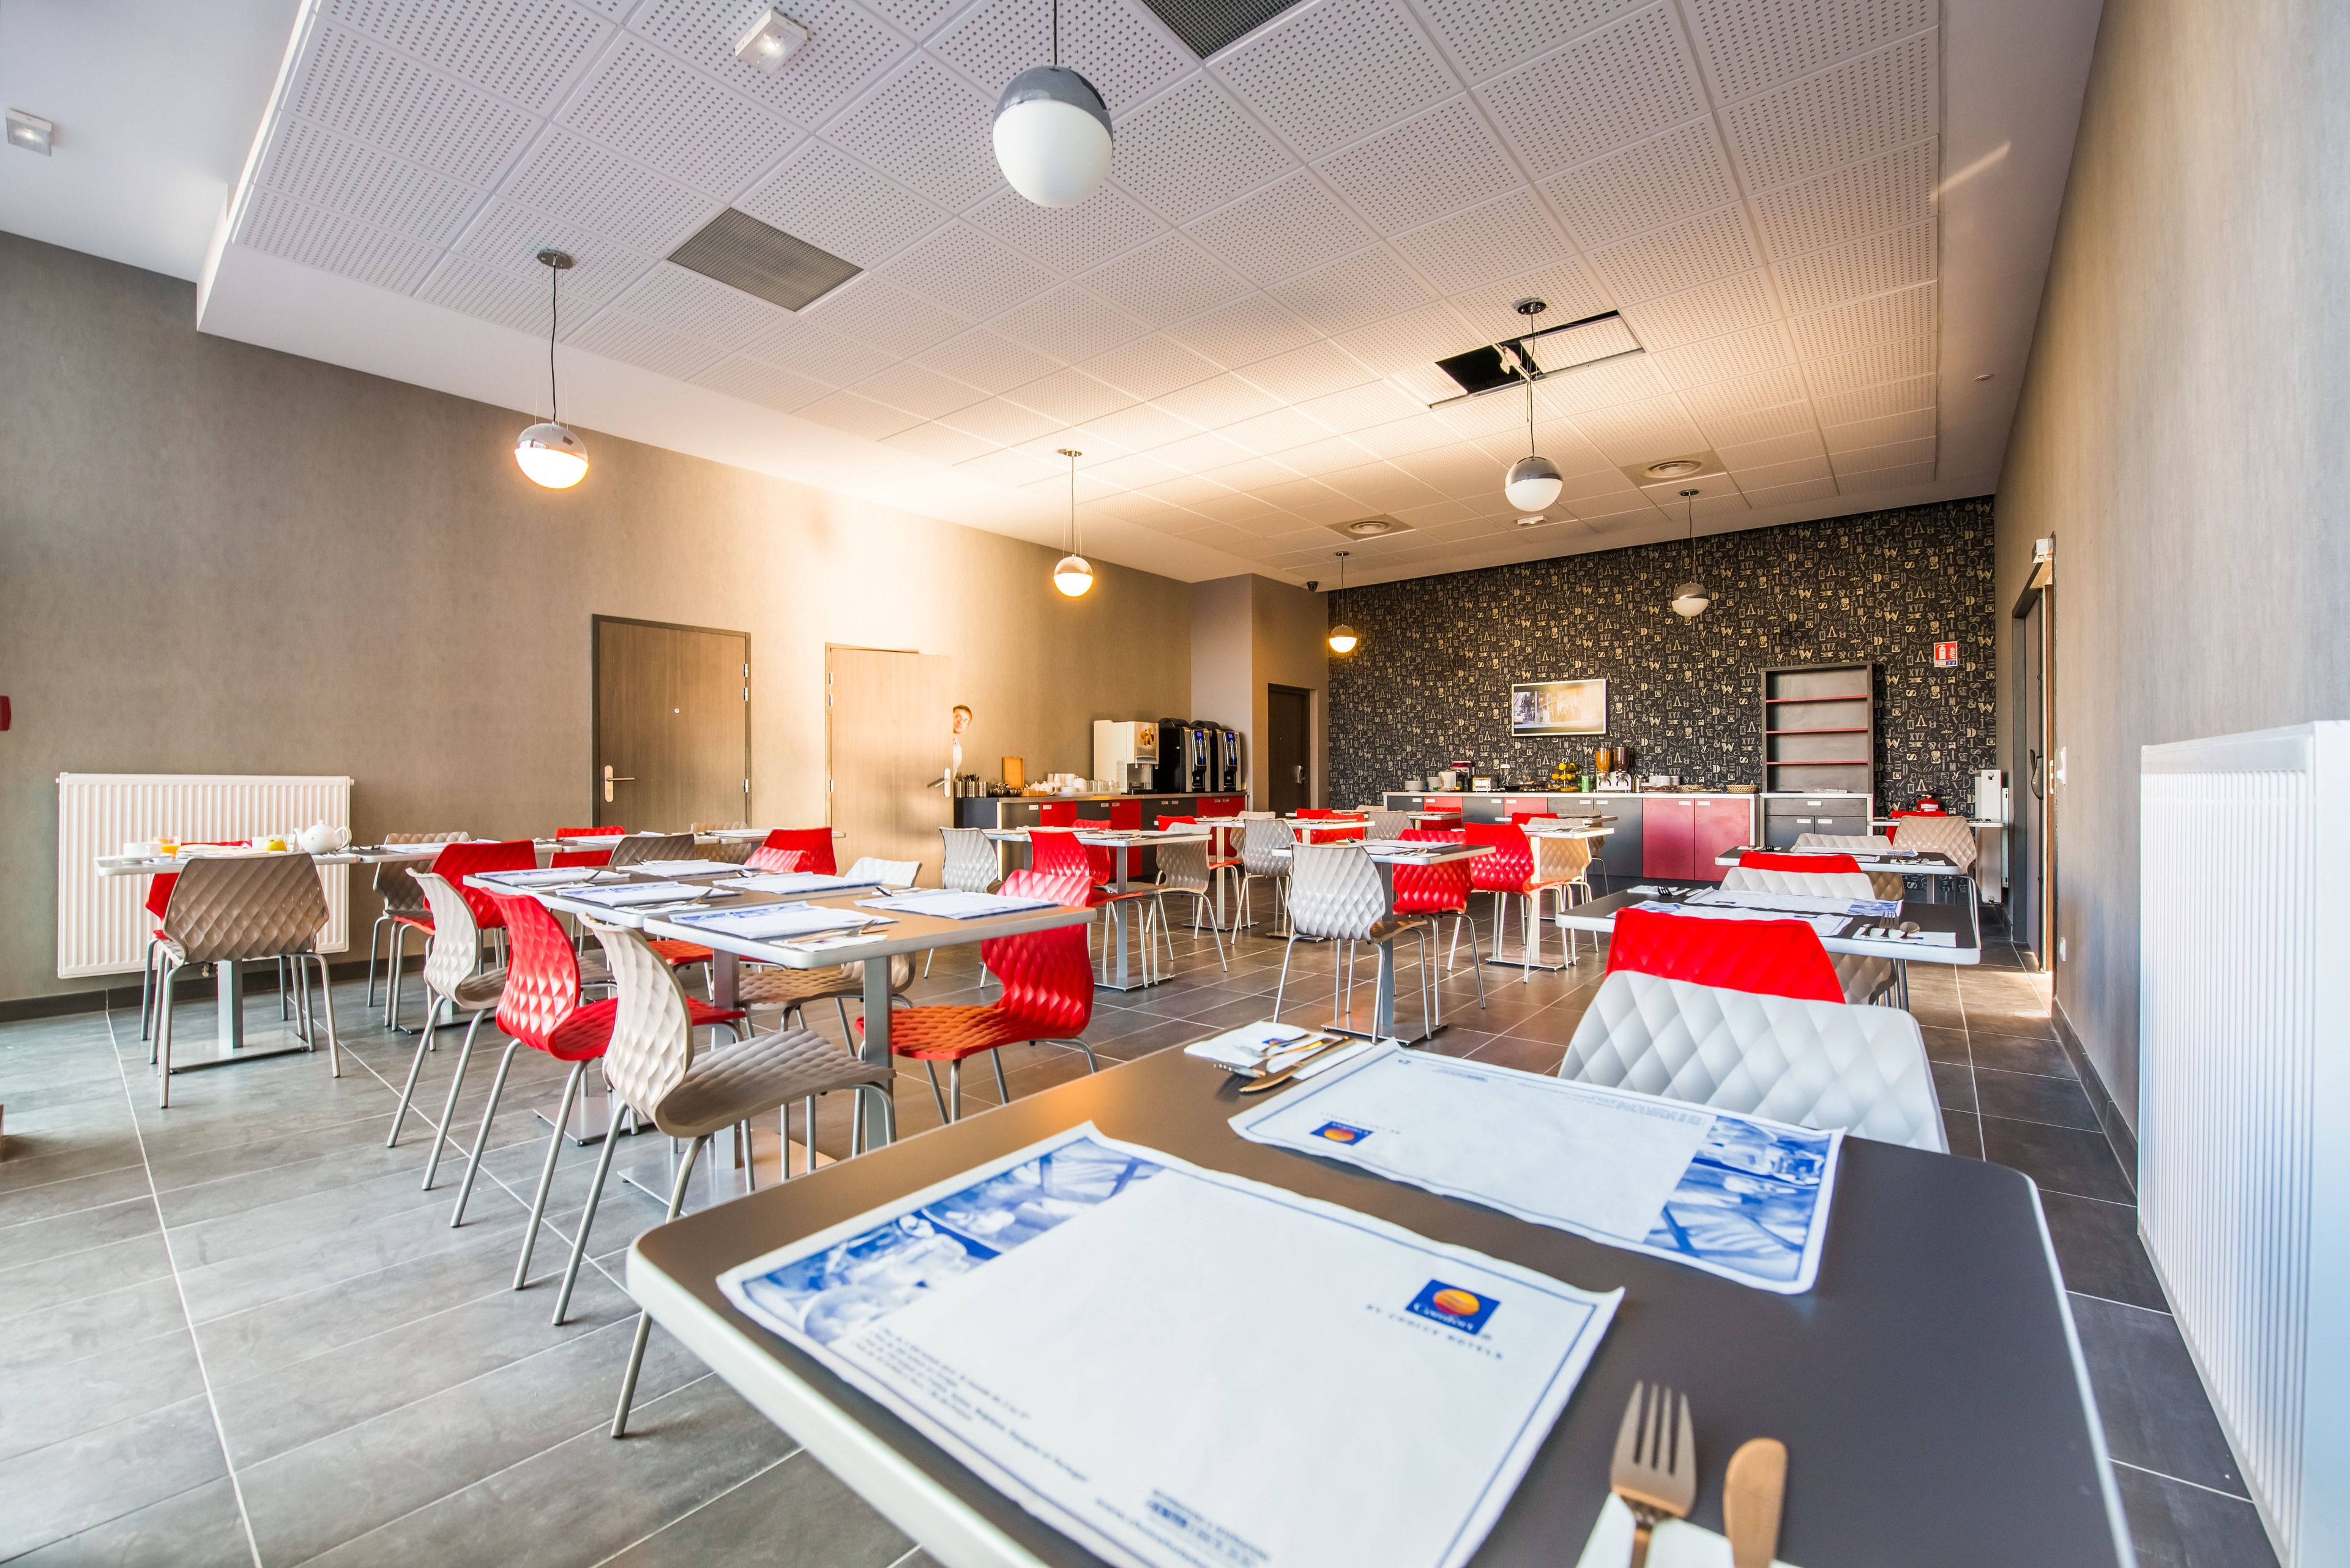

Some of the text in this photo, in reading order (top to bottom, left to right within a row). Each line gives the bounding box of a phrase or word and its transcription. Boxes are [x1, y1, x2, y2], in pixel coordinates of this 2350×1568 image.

[1977, 502, 1993, 515] W
[1798, 528, 1811, 539] W
[1908, 539, 1923, 548] XYZ
[1648, 550, 1659, 560] W
[1884, 547, 1898, 559] W
[1740, 561, 1753, 570] XYZ
[1720, 569, 1732, 579] W
[1978, 569, 1994, 581] W
[1582, 586, 1592, 595] W
[1820, 581, 1834, 590] XYZ
[1798, 589, 1811, 599] W
[1648, 605, 1660, 615] W
[1908, 603, 1923, 613] XYZ
[1884, 611, 1899, 622] W
[1720, 626, 1733, 637] W
[1583, 640, 1593, 649] W
[1979, 635, 1994, 647] W
[1821, 643, 1835, 651] XYZ
[1799, 649, 1812, 660] W
[1649, 661, 1660, 670] W
[1909, 668, 1924, 676] XYZ
[1885, 674, 1900, 685] W
[1721, 684, 1733, 694] W
[1979, 702, 1996, 713] W
[1649, 717, 1660, 726] W
[1909, 732, 1925, 741] XYZ
[1721, 742, 1734, 752] W
[1886, 738, 1900, 748] W
